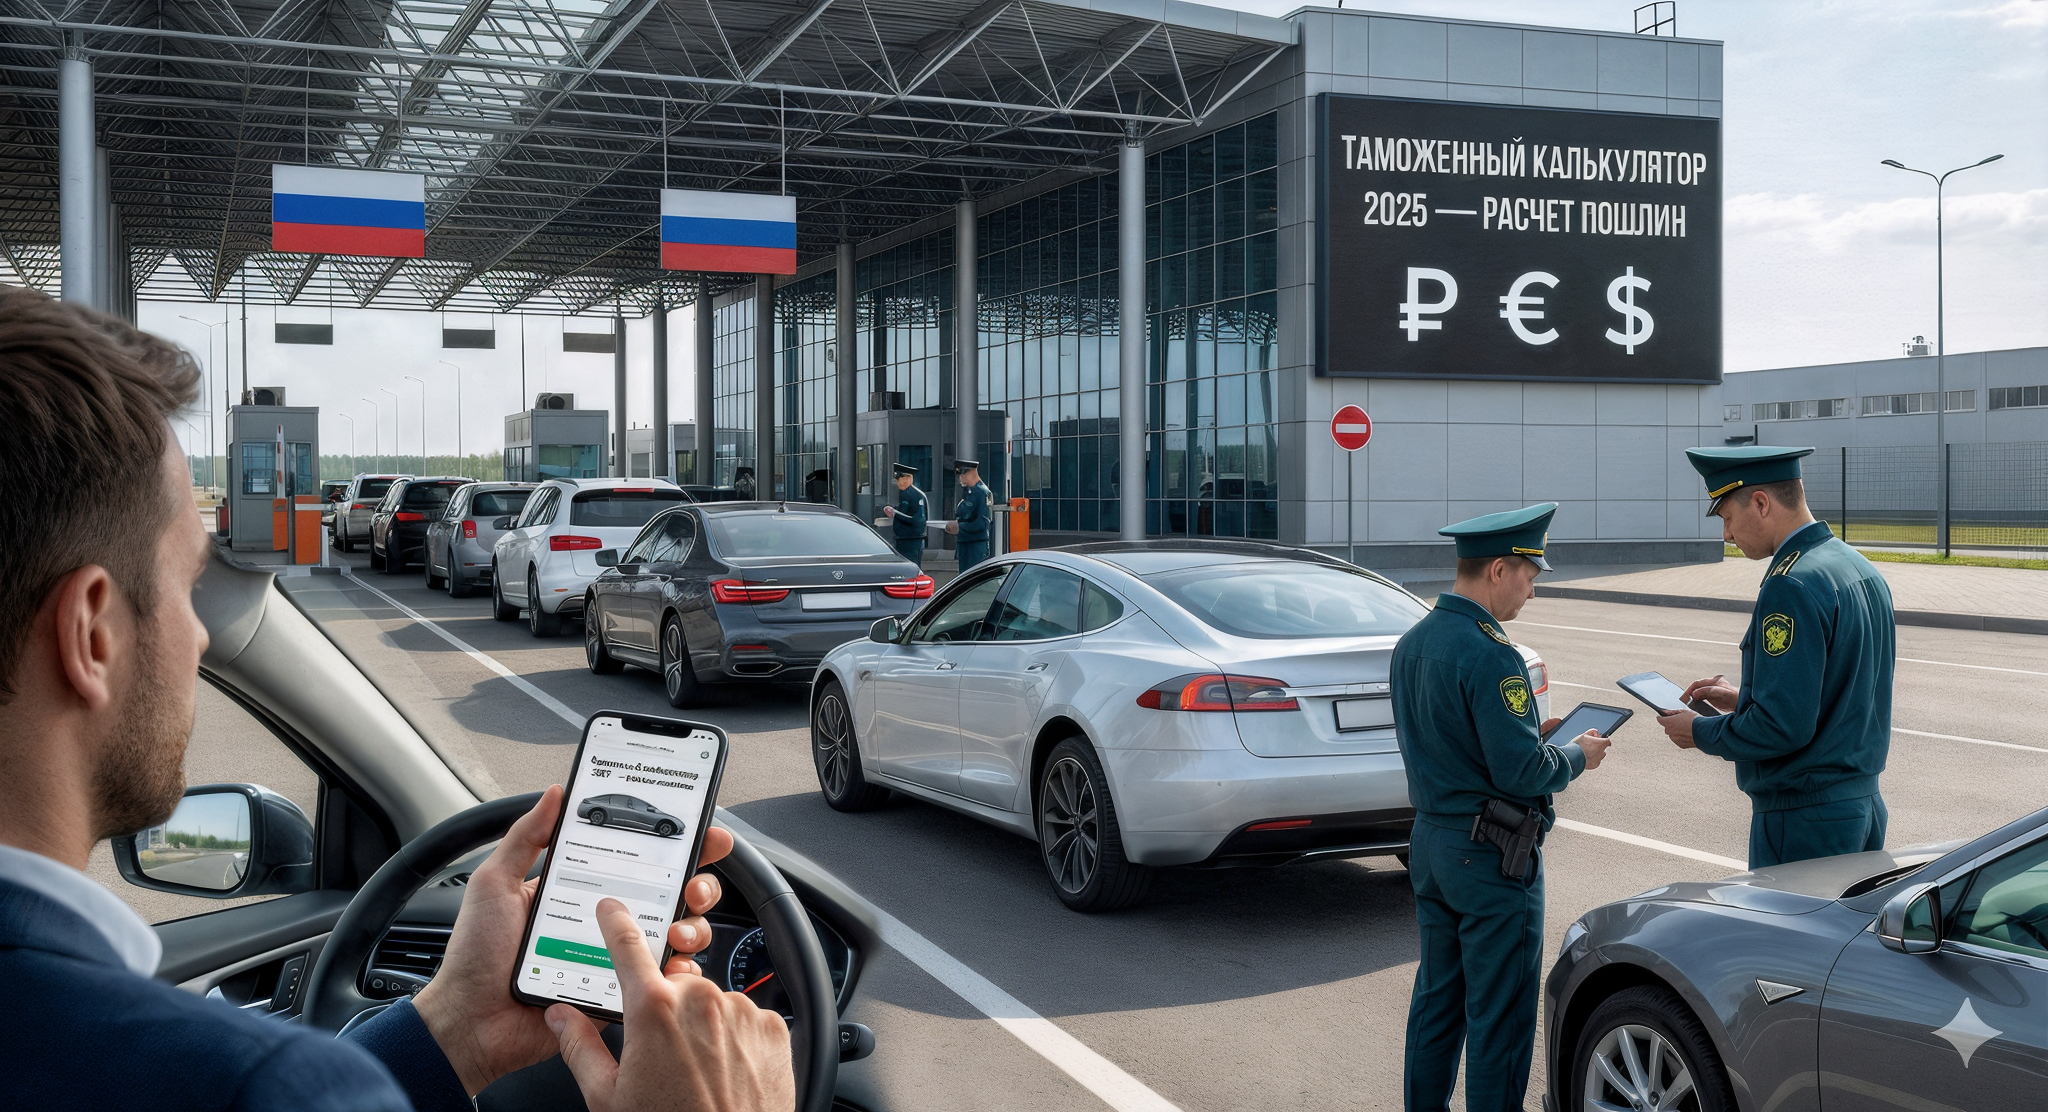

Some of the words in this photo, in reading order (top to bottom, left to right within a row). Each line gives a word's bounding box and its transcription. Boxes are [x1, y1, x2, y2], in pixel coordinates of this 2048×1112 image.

[1341, 135, 1526, 178] ТАМОЖЕННЫЙ
[1533, 144, 1707, 186] КАЛЬКУЛЯТОР
[1363, 190, 1428, 228] 2025
[1483, 196, 1575, 233] РАСЧЕТ
[1581, 201, 1686, 238] ПОШЛИН
[1499, 270, 1561, 346] €
[1604, 265, 1655, 355] $
